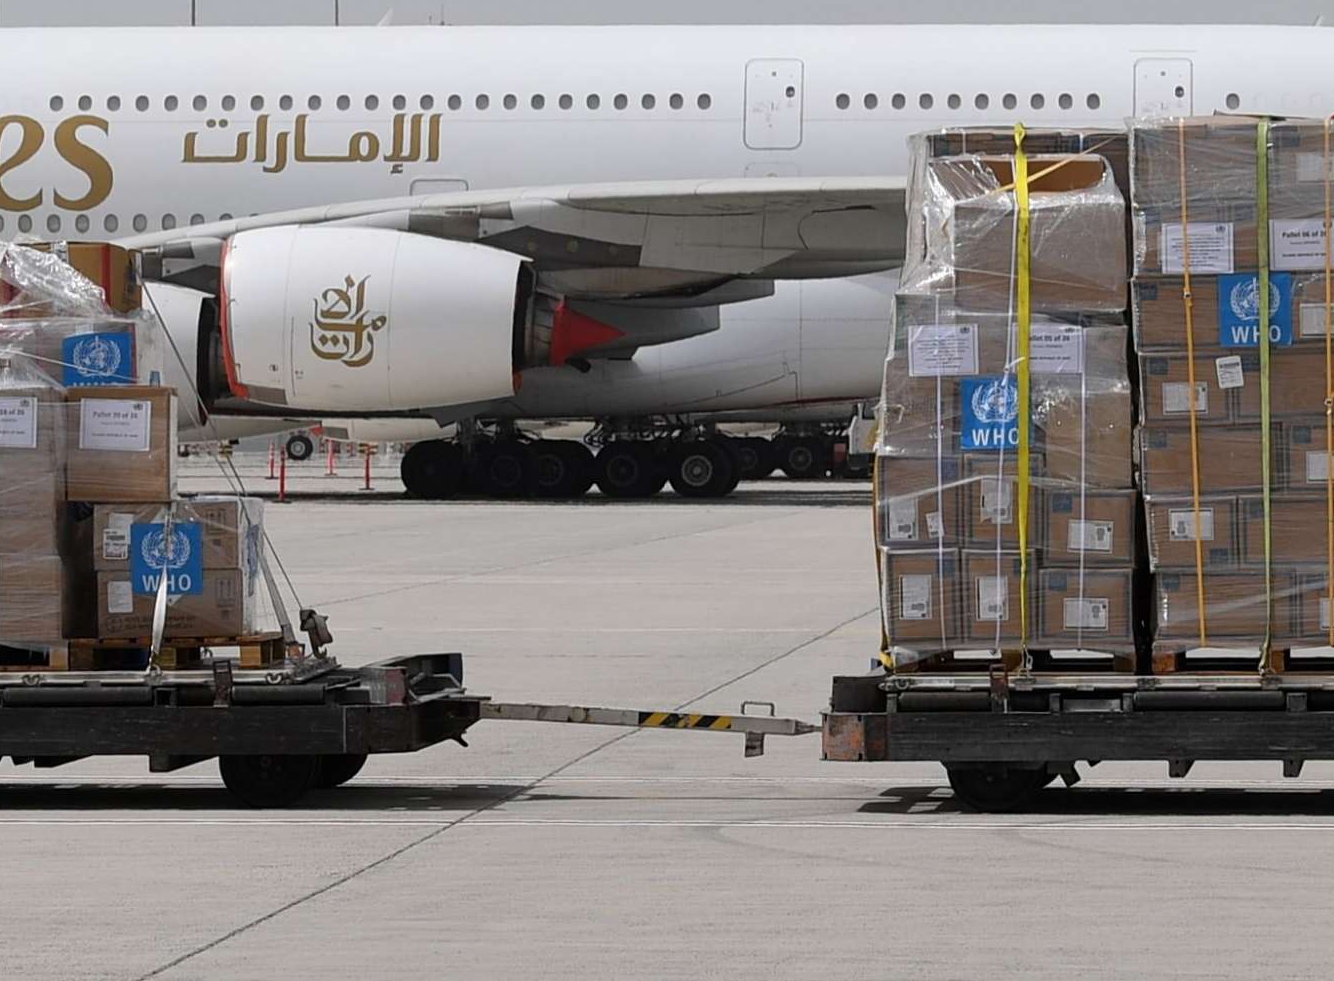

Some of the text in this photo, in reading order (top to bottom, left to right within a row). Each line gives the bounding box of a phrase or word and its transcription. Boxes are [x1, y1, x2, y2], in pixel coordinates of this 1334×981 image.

[1231, 324, 1281, 344] WHO
[972, 428, 1019, 446] WHO
[142, 574, 192, 592] WHO
